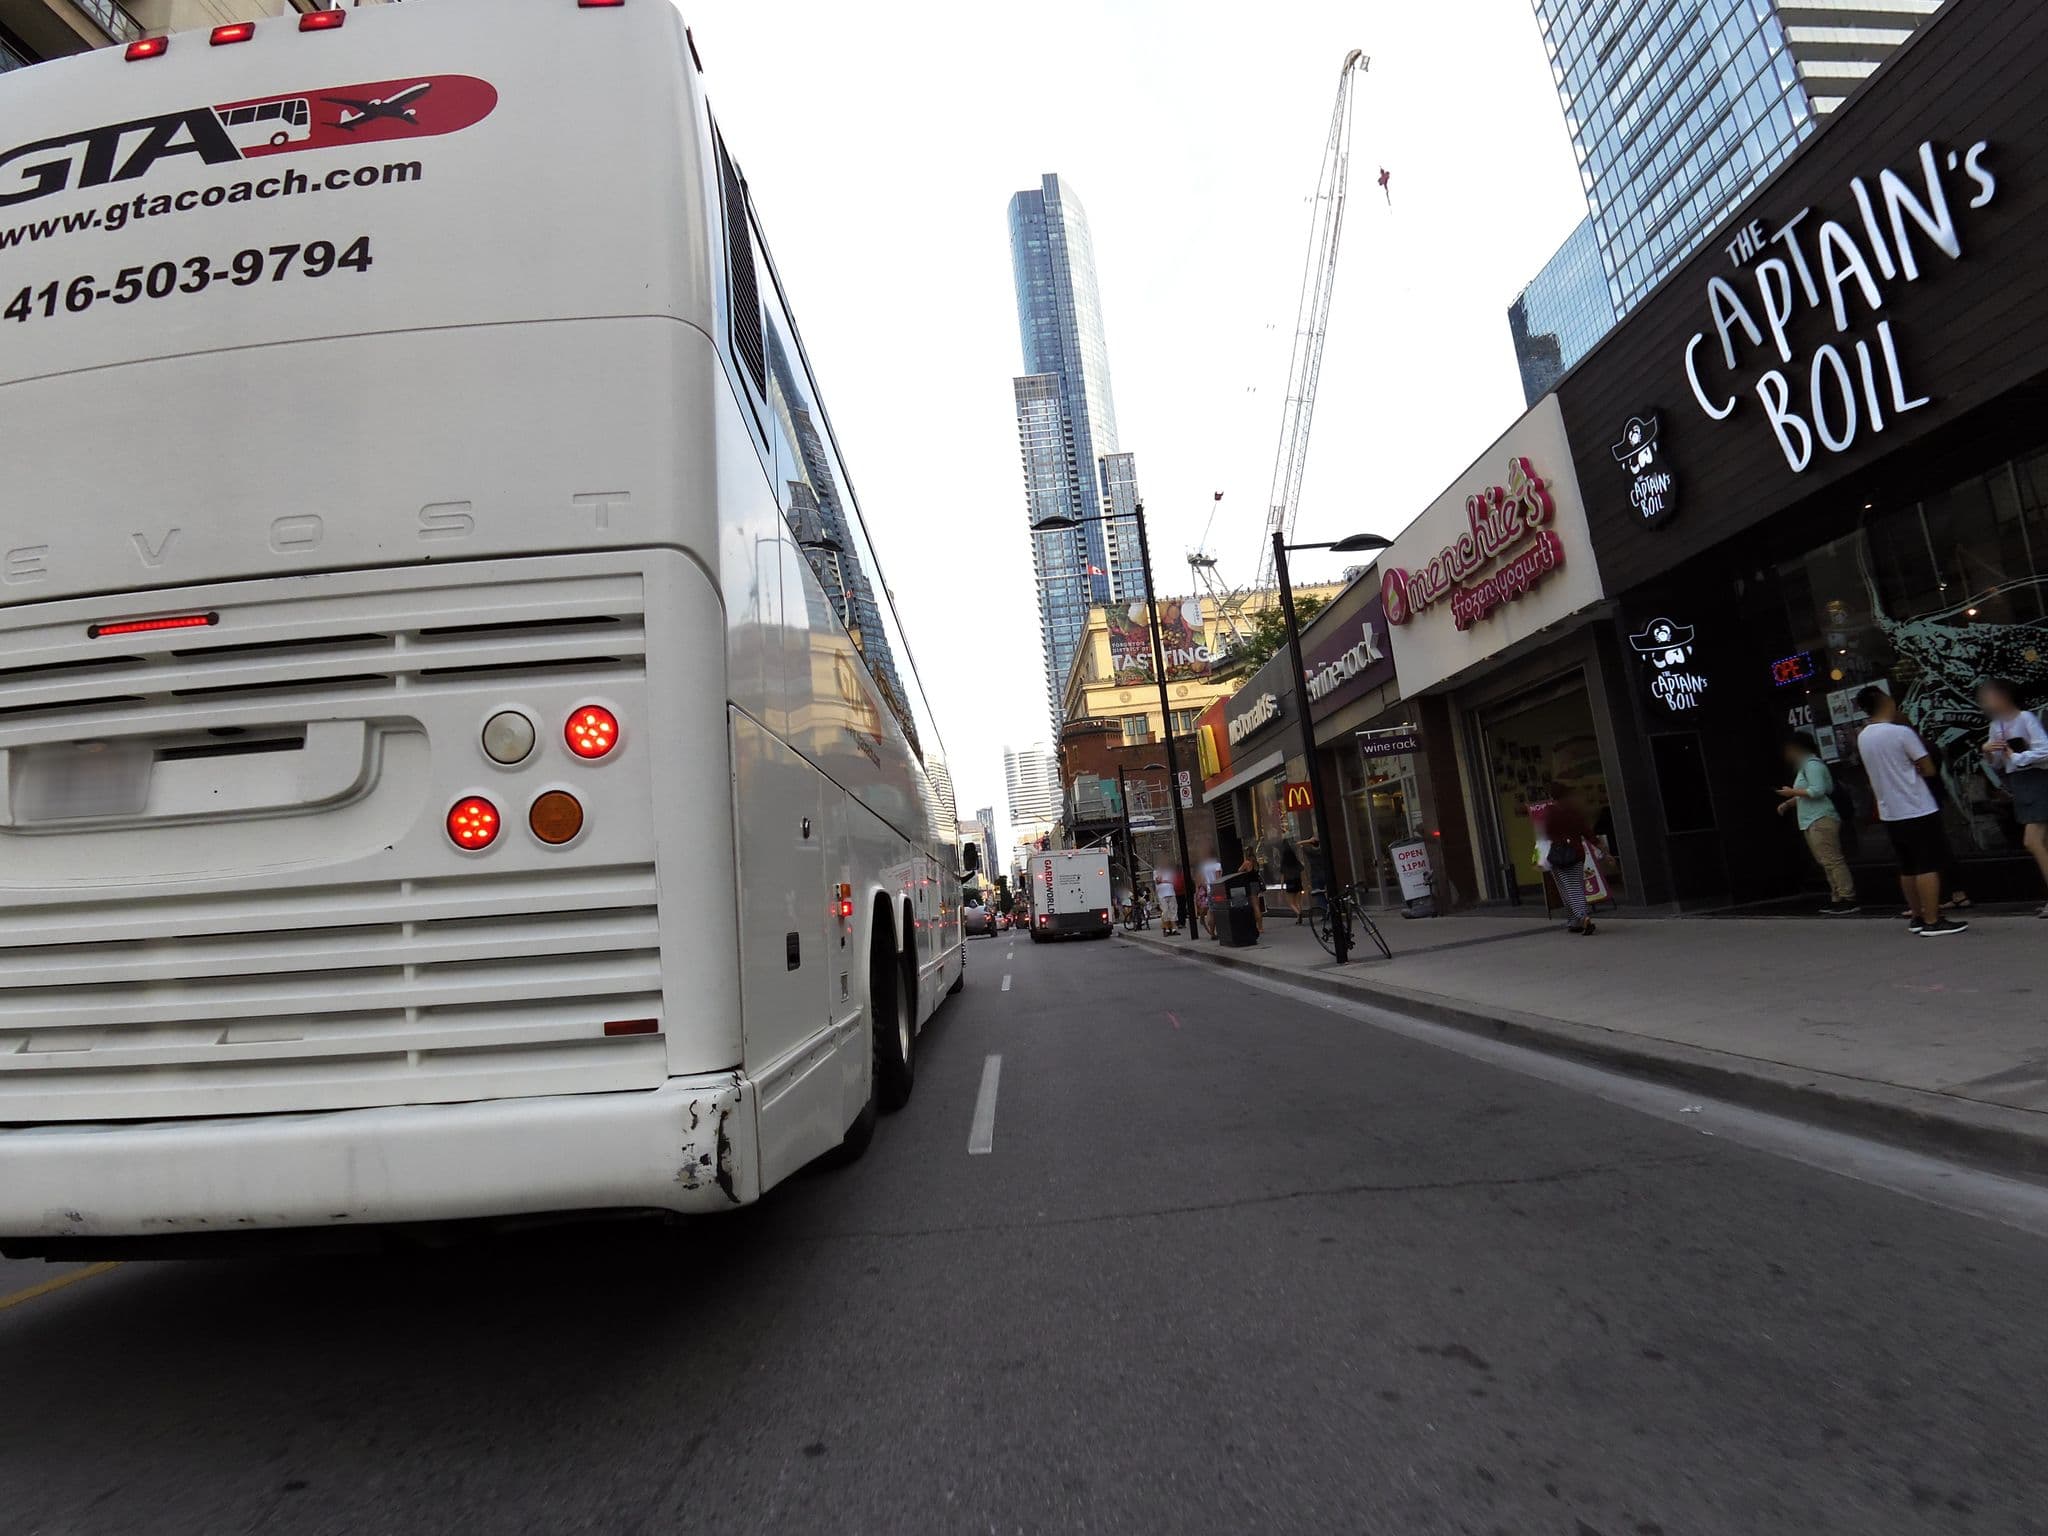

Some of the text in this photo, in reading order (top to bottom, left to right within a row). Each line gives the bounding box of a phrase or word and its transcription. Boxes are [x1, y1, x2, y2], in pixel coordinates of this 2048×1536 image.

[0, 106, 243, 207] GTA
[0, 158, 422, 250] www.gtacoach.com
[1725, 218, 1766, 268] THE
[3, 236, 373, 323] 416-503-9794
[1756, 320, 1930, 473] BOIL
[1406, 457, 1552, 614] menchie's
[1640, 494, 1665, 518] BOIL
[1453, 532, 1555, 628] frozen yogurt
[1309, 622, 1384, 700] wine rack
[1665, 692, 1699, 711] BOIL
[1363, 737, 1417, 753] wine rack
[1044, 859, 1055, 914] GARDAWORLD
[1398, 849, 1424, 860] OPEN
[1401, 860, 1426, 872] 11PM
